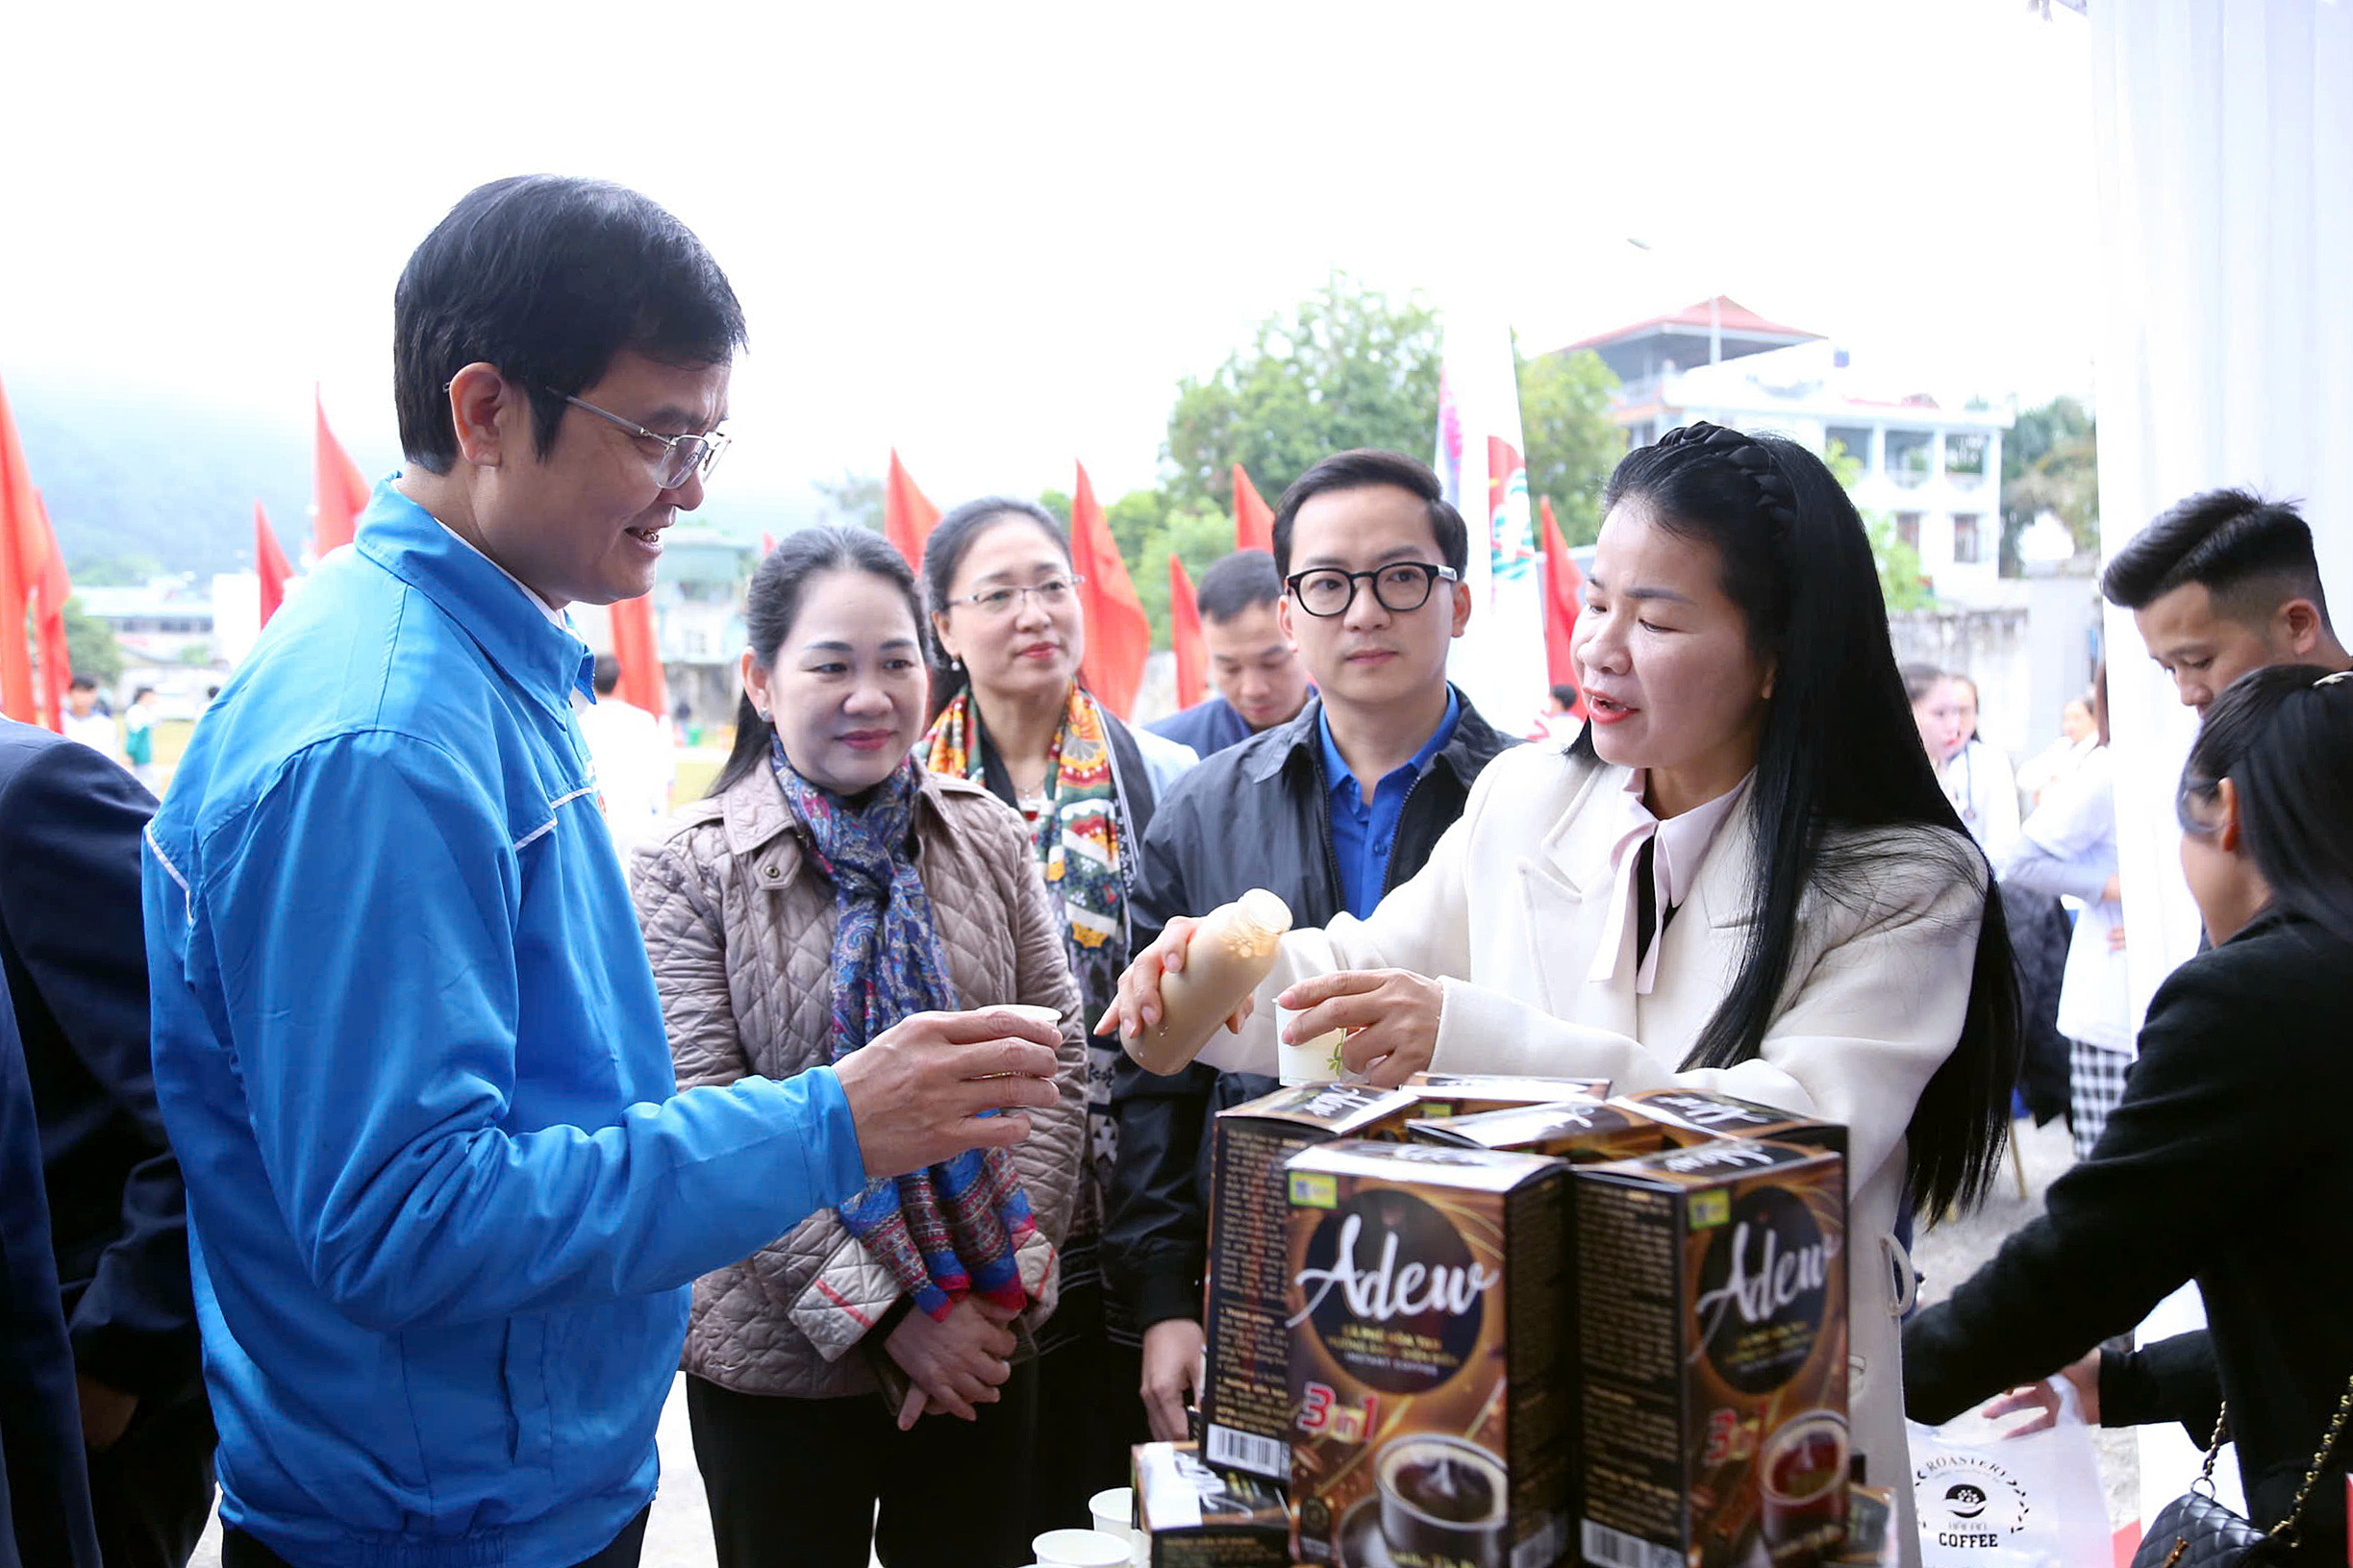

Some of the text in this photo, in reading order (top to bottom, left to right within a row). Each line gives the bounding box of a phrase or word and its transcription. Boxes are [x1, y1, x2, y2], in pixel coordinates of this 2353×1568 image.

[1284, 1212, 1500, 1329] Adew
[1685, 1220, 1842, 1364] Adew
[1938, 1531, 1998, 1548] COFFEE
